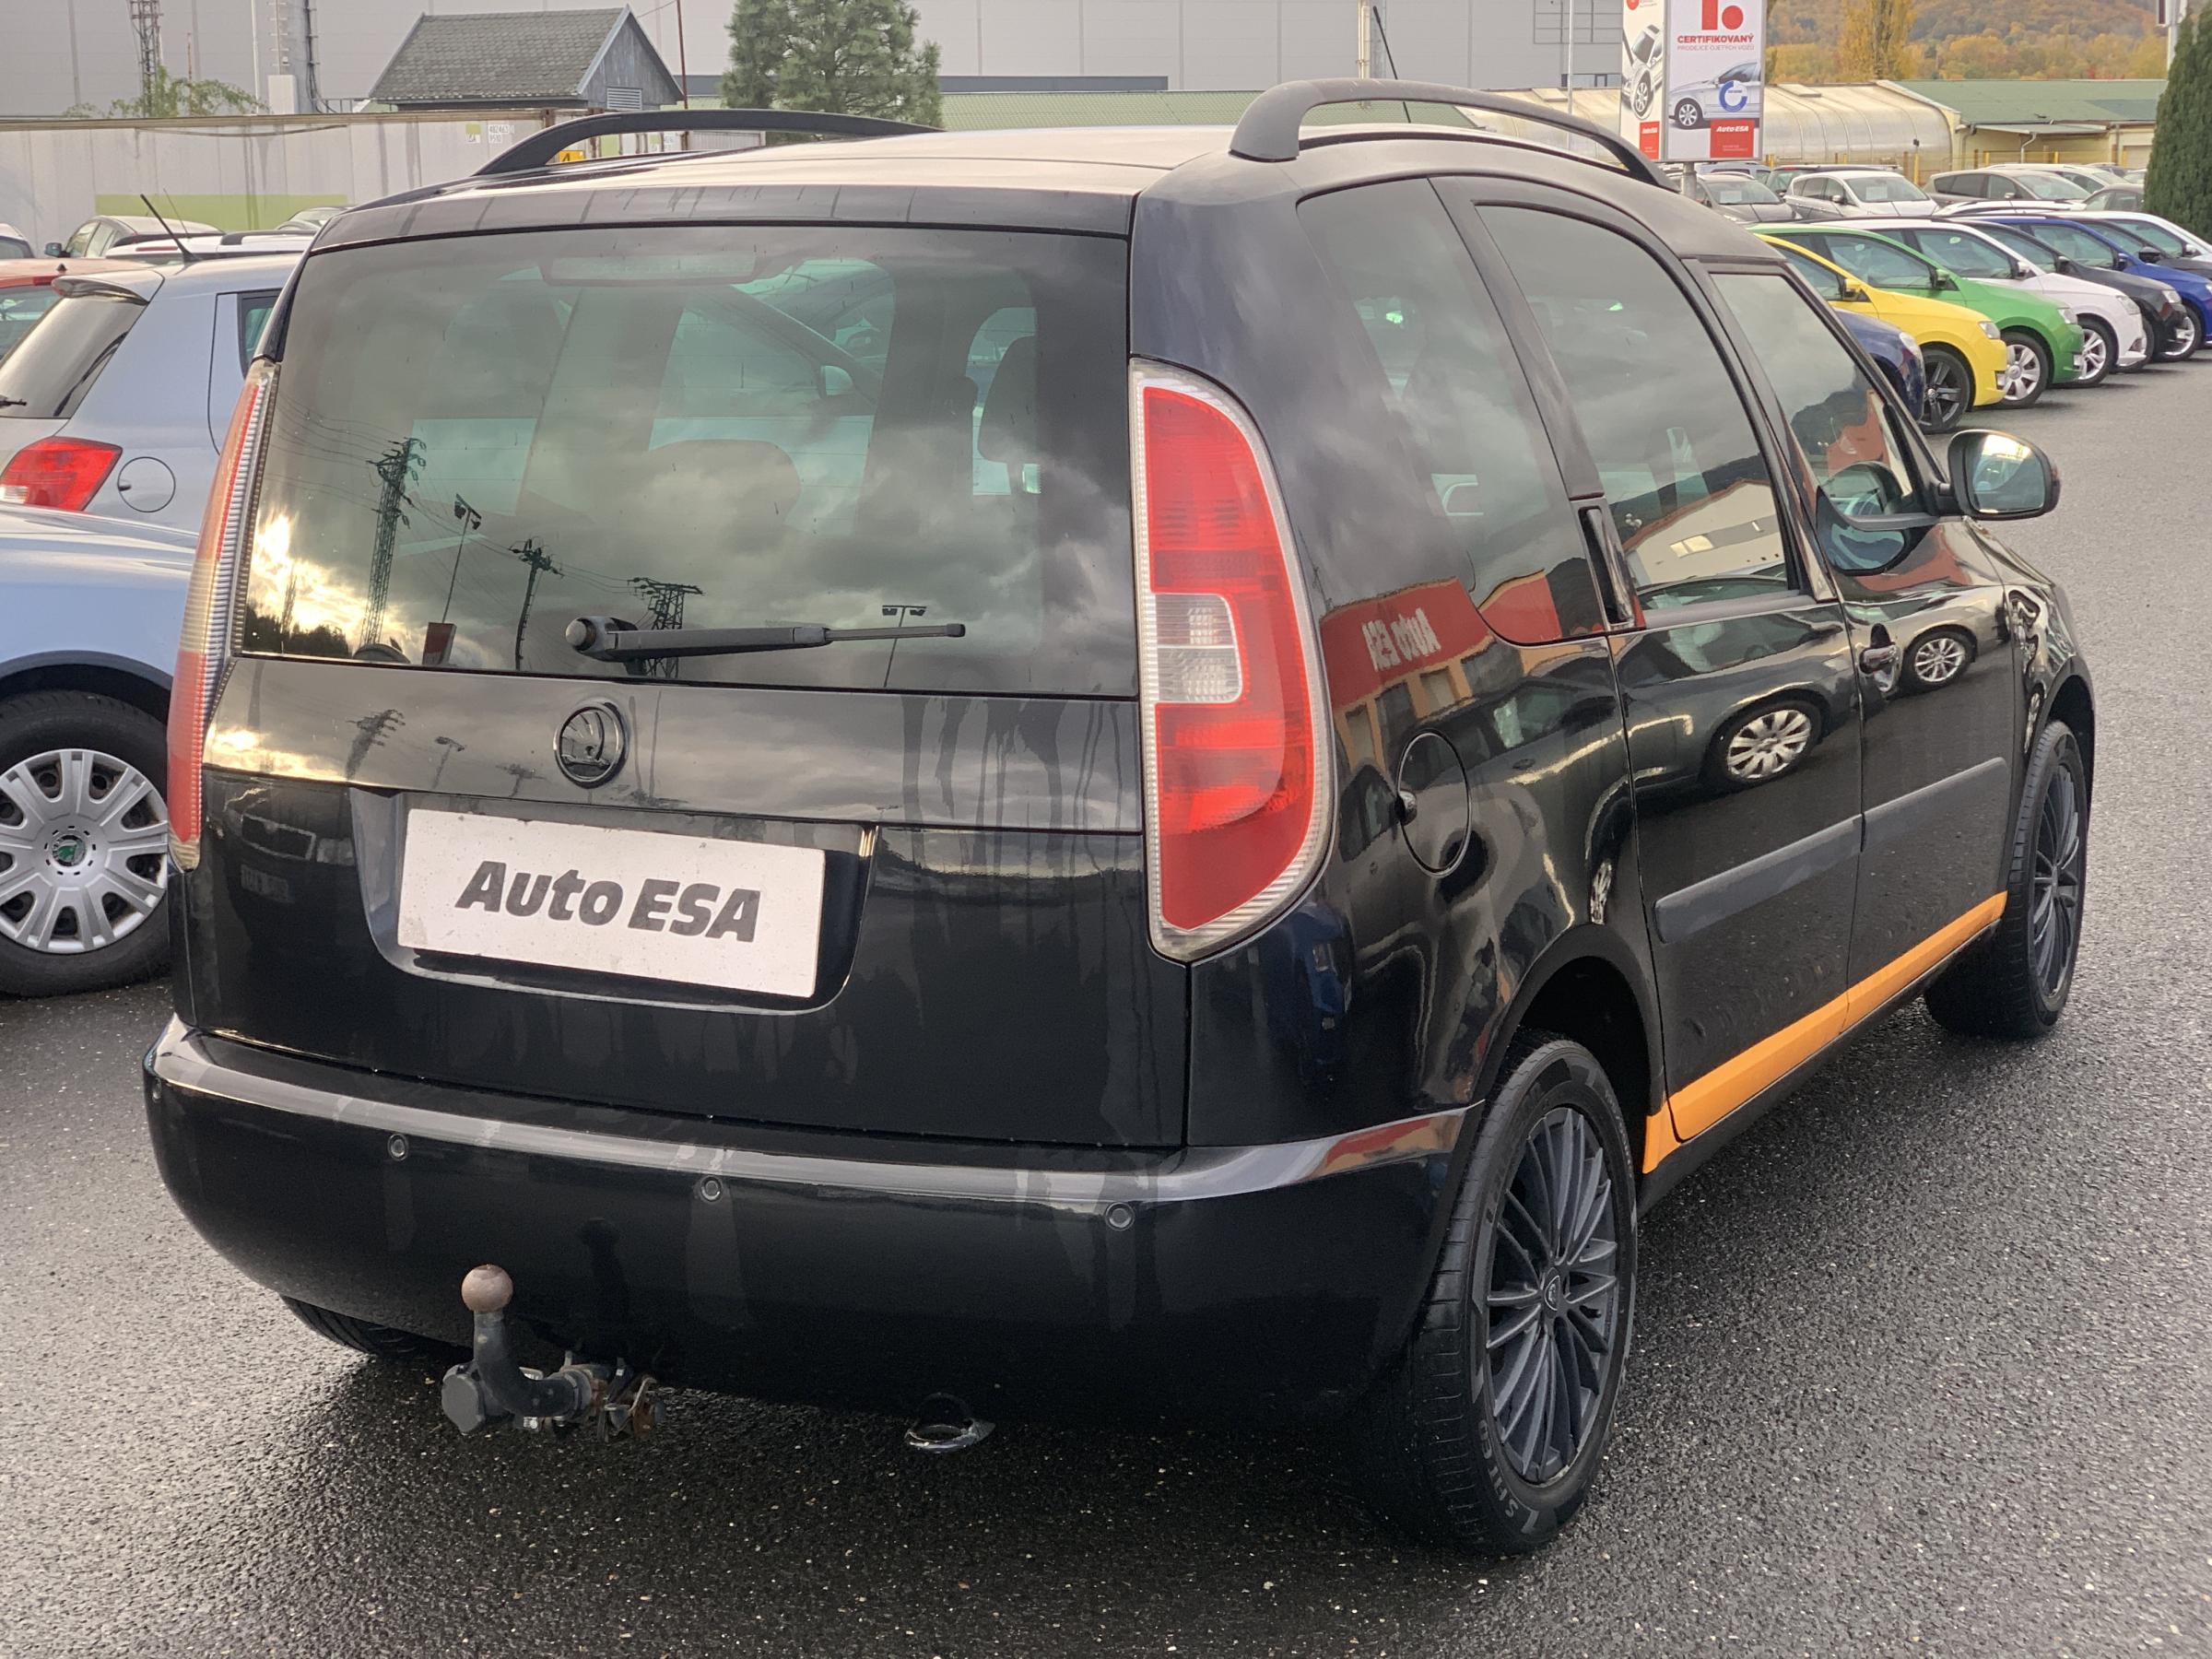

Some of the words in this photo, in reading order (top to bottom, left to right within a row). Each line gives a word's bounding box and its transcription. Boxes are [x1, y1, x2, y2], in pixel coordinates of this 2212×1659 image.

[1677, 33, 1755, 44] CERTIFIKOVANÝ
[454, 860, 624, 926] Auto
[627, 877, 760, 943] ESA
